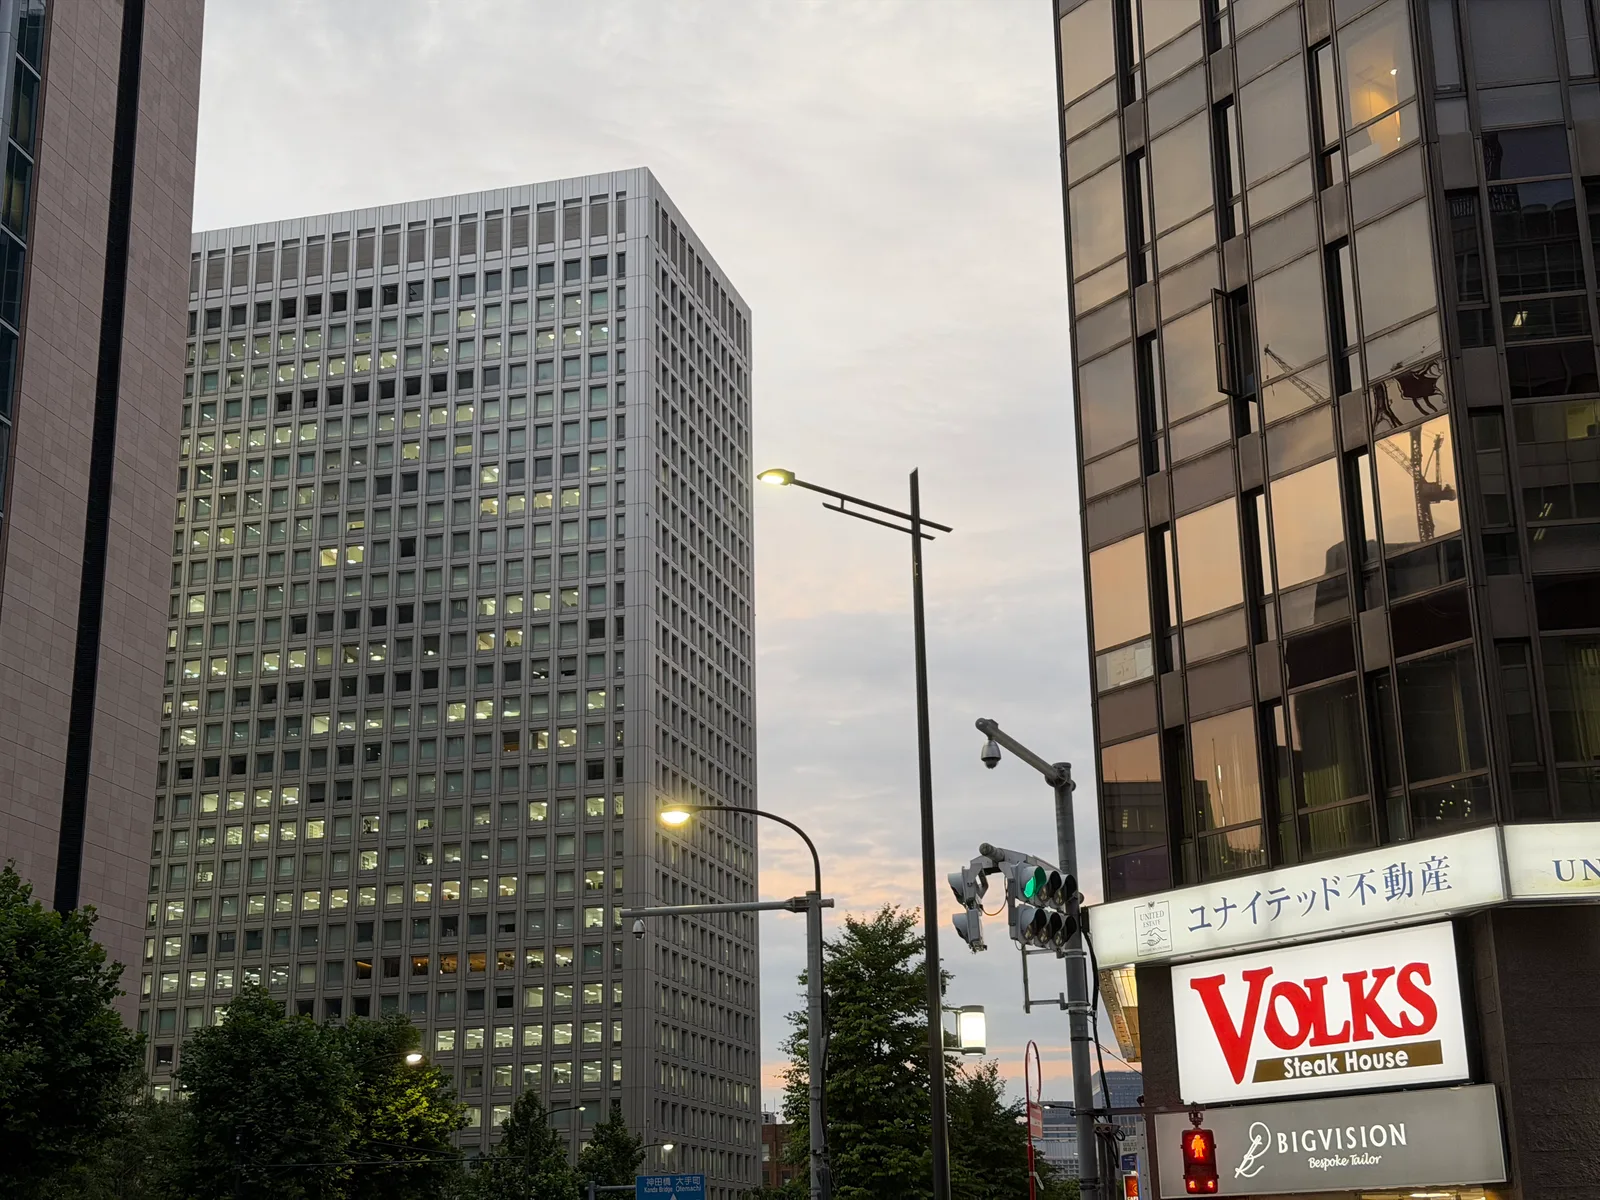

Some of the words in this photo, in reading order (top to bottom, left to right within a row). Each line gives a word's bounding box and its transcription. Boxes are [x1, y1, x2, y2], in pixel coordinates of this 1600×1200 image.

[1187, 855, 1453, 933] ユナイテッド不動産
[1140, 910, 1165, 922] UNITED
[1190, 962, 1438, 1085] VOLKS
[1283, 1055, 1339, 1079] Steak
[1344, 1049, 1409, 1073] House
[1276, 1122, 1408, 1154] BIGVISION
[1308, 1154, 1350, 1172] Bespoke
[1349, 1152, 1382, 1167] Tailor
